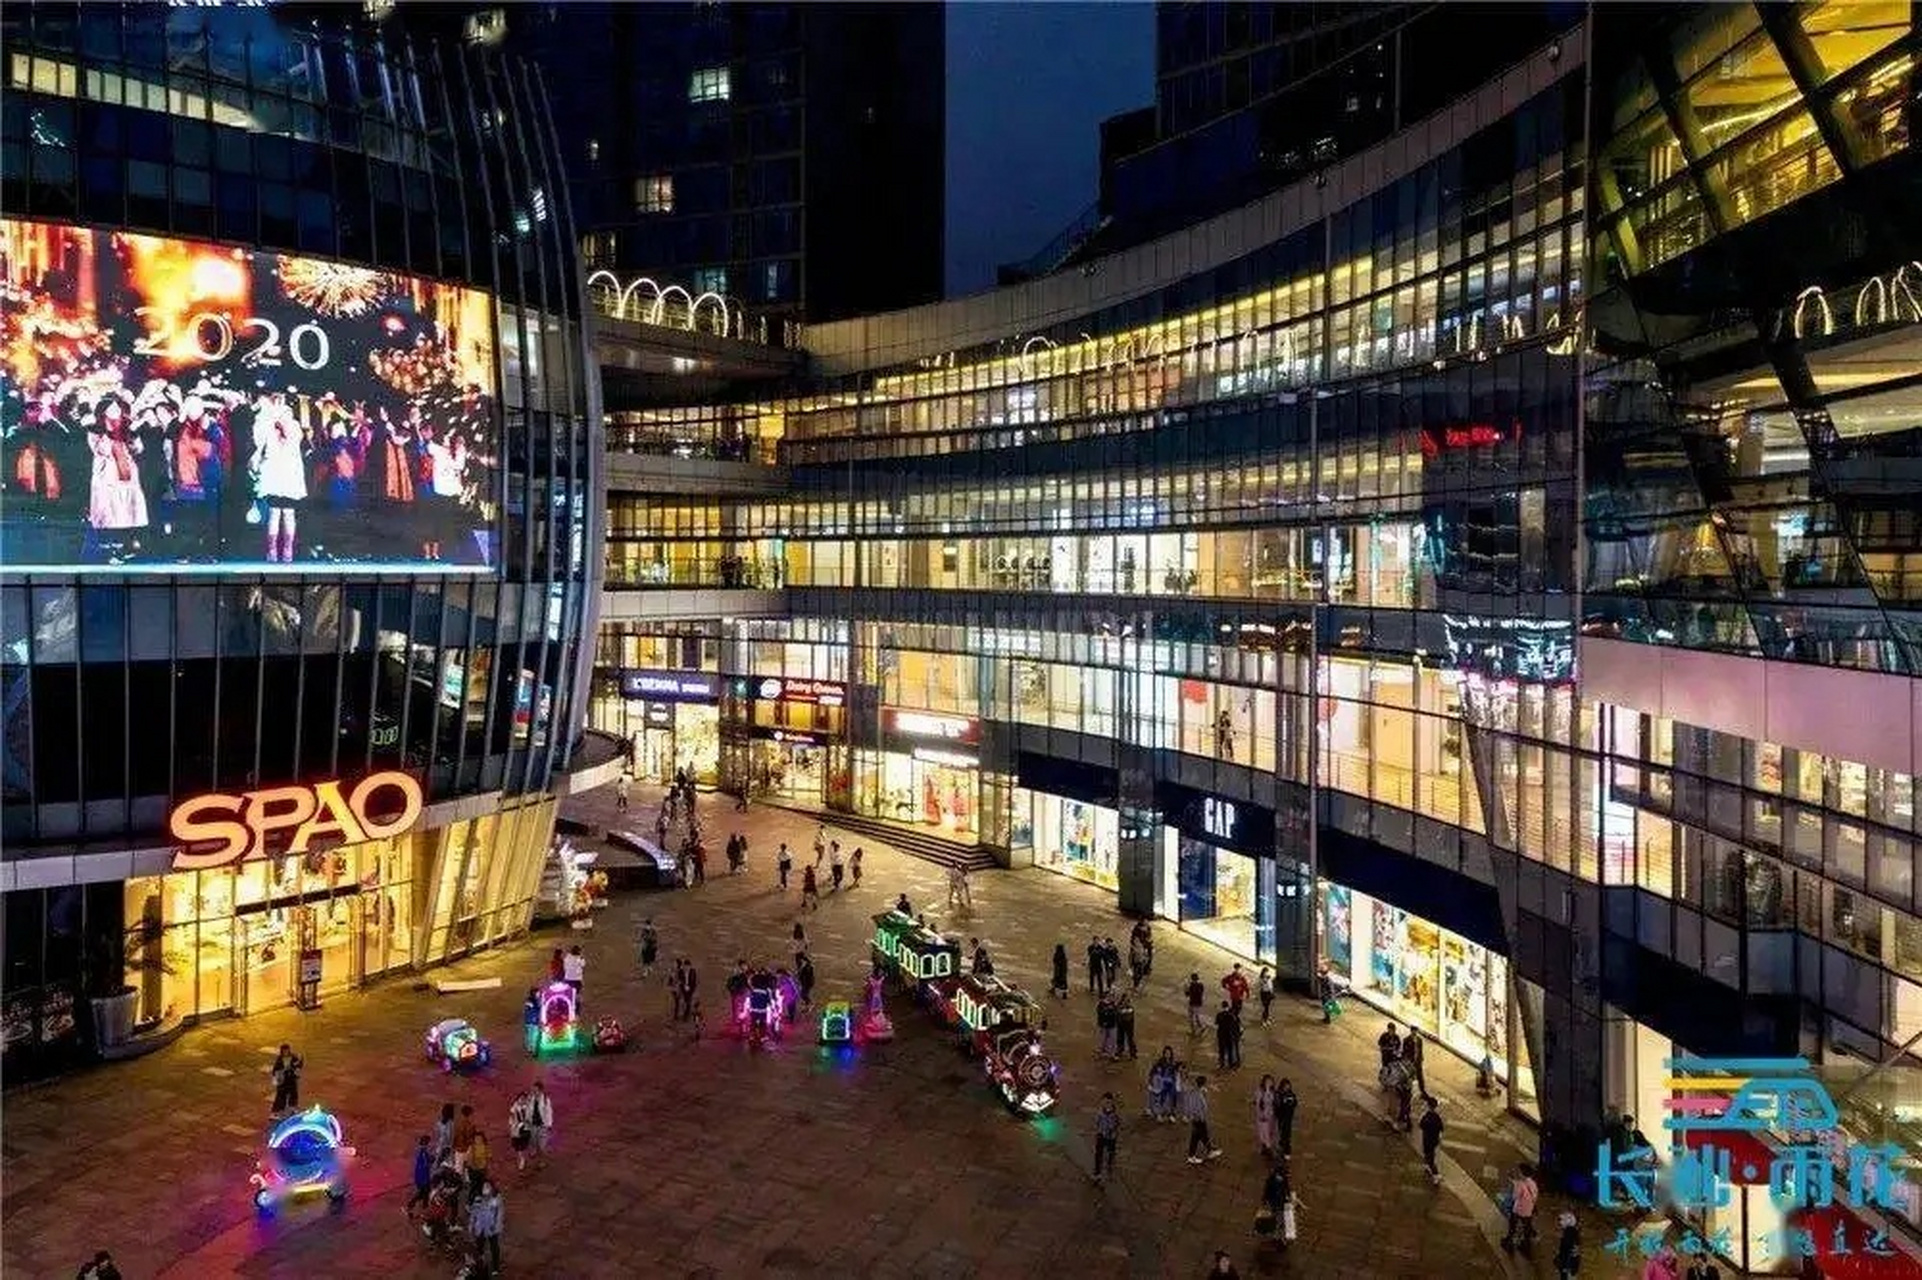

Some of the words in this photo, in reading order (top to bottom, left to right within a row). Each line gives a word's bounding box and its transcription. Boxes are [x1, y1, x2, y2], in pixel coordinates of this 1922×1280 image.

[134, 306, 330, 370] 2020
[170, 770, 423, 869] SPAO
[1204, 797, 1235, 839] GAP
